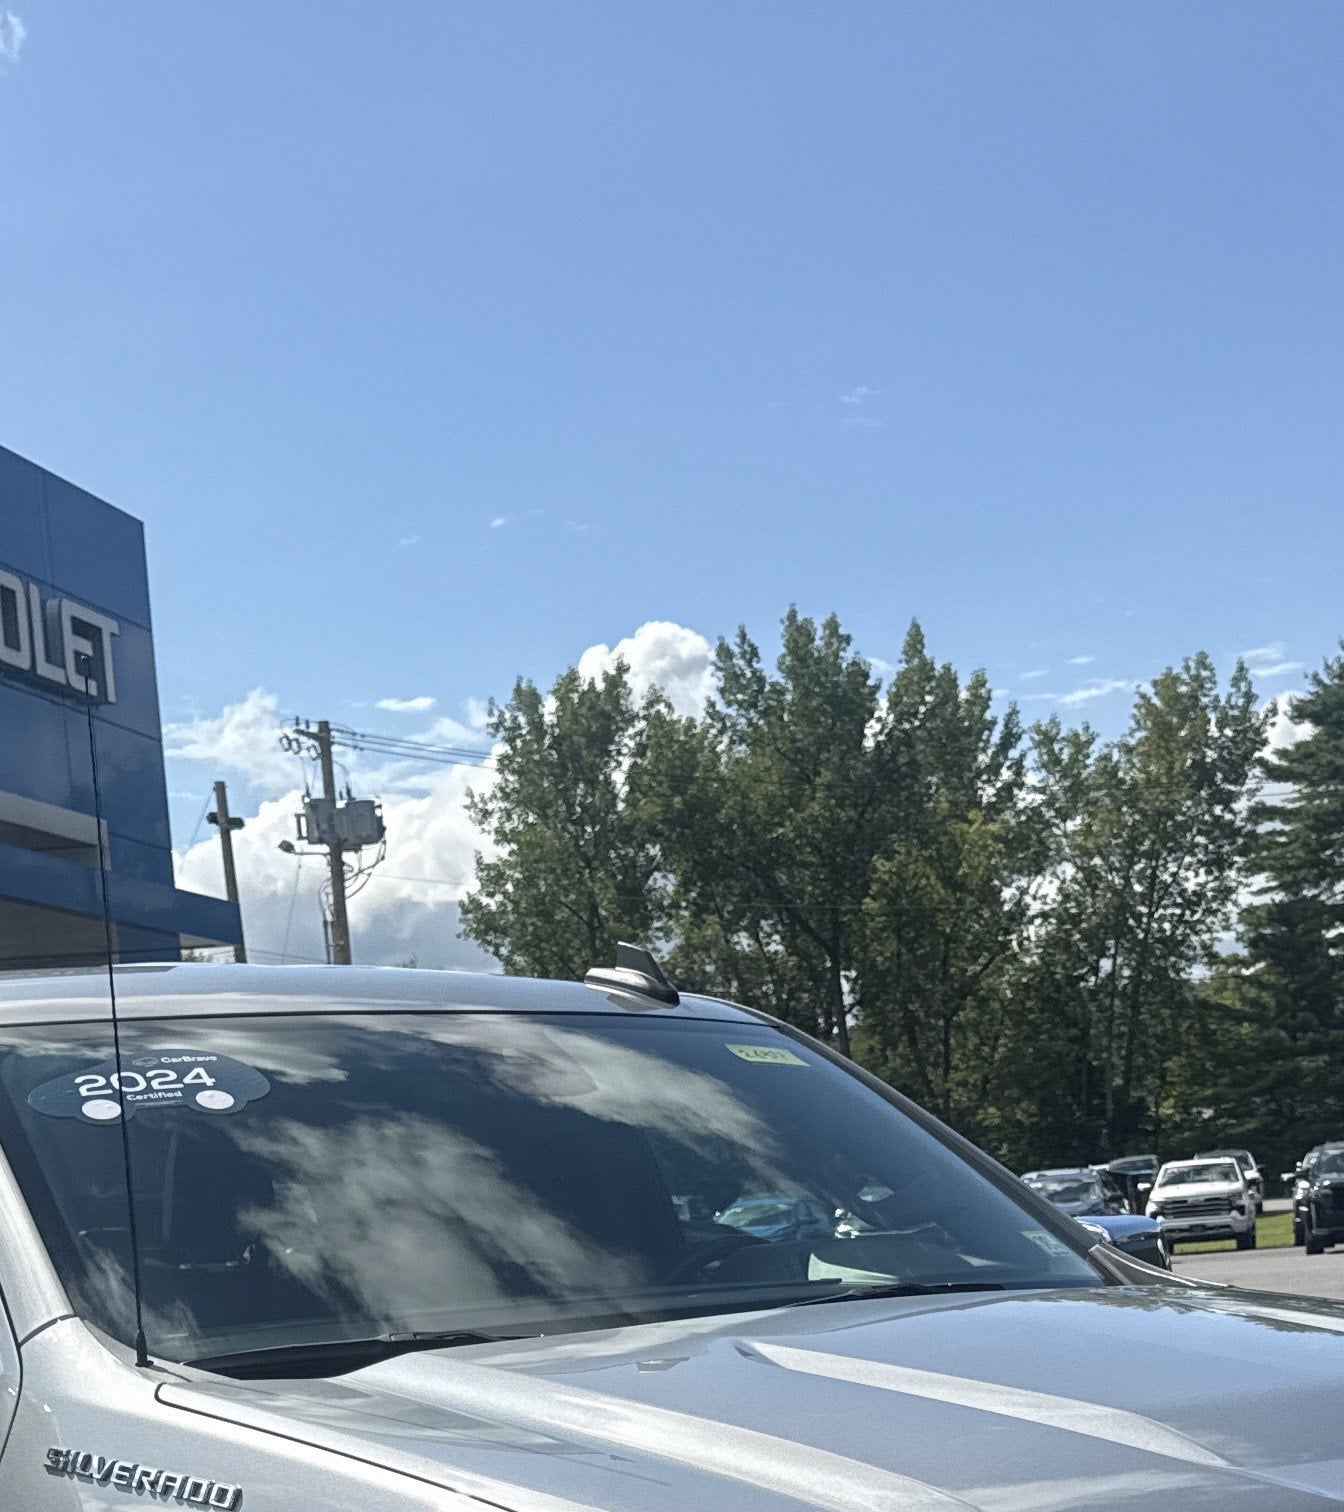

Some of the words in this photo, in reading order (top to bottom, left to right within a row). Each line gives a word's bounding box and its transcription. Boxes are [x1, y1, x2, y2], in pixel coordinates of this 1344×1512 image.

[74, 1067, 216, 1097] 2024
[126, 1091, 183, 1101] Certified
[45, 1447, 241, 1512] SILVERADO
